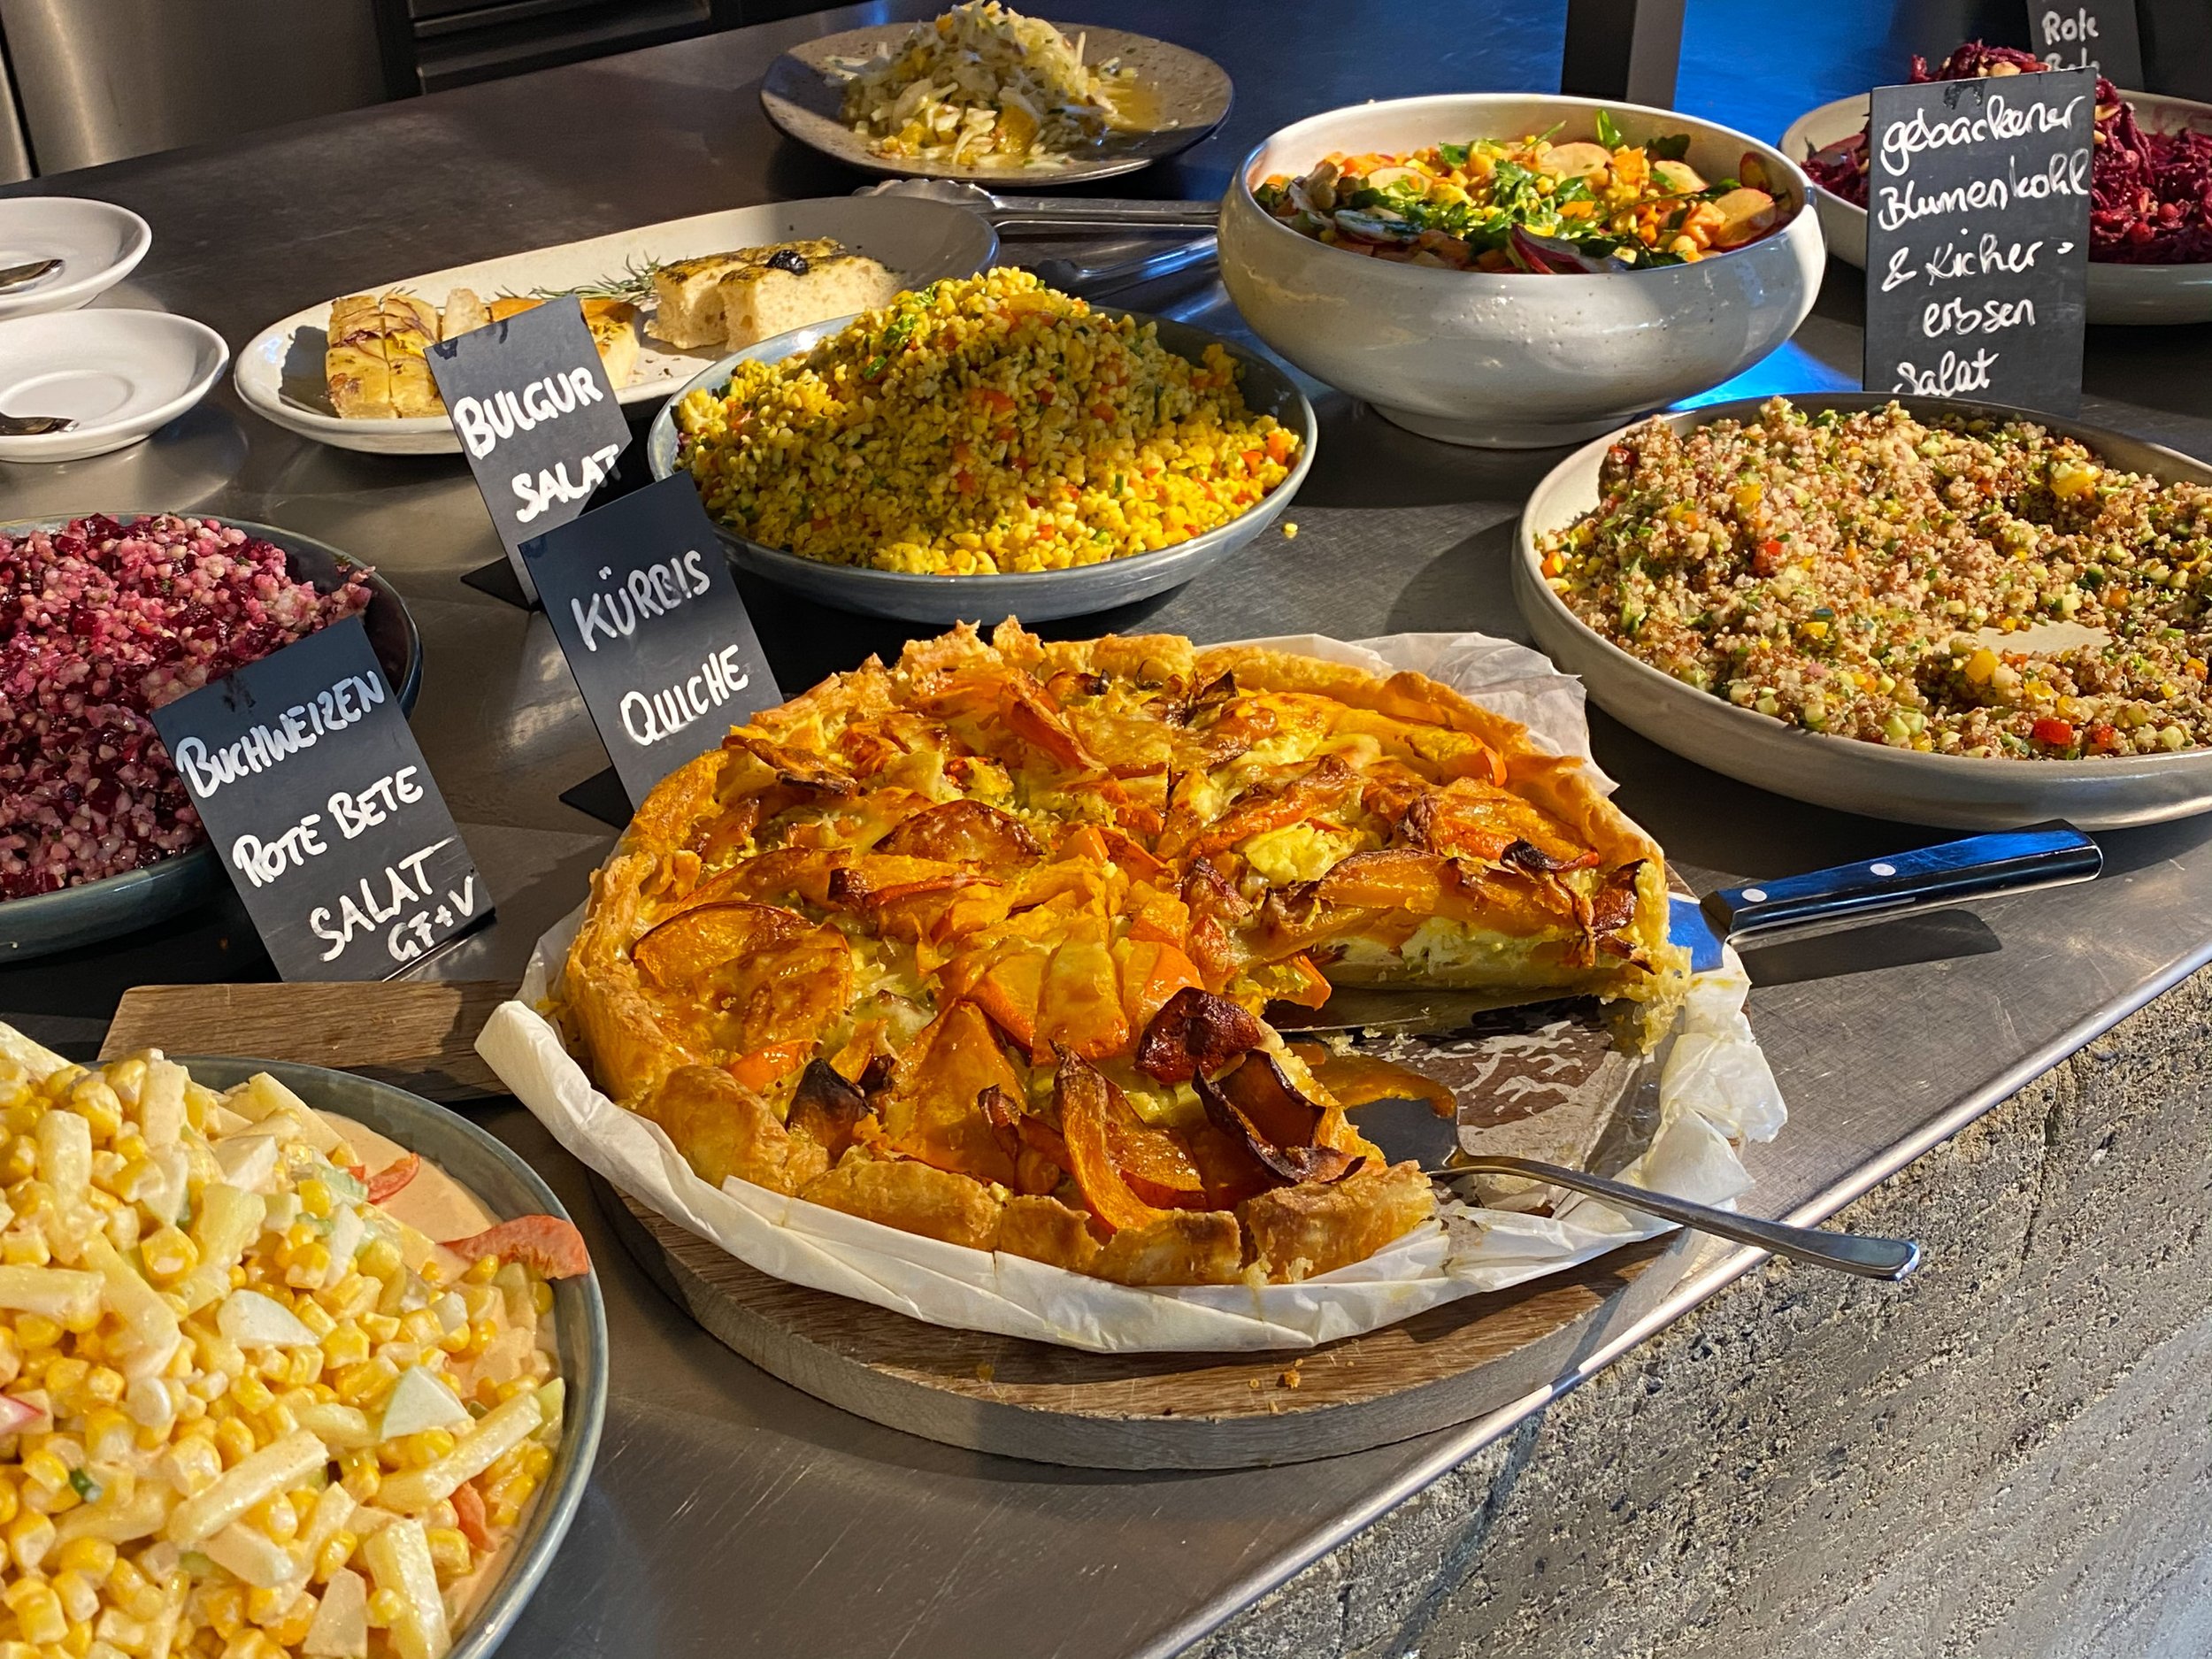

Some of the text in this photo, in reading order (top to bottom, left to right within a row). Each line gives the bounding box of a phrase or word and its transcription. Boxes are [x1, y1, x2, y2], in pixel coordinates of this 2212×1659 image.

[1881, 95, 2085, 176] gebackener
[1878, 149, 2089, 231] Blumenkohl
[1882, 247, 1916, 292] &
[453, 367, 604, 459] BULGUR
[511, 443, 622, 523] SALAT
[177, 670, 385, 798] BUCHWEIZEN
[619, 644, 749, 746] QUICHE
[232, 764, 424, 887] ROTE BETE
[310, 834, 458, 962] SALAT
